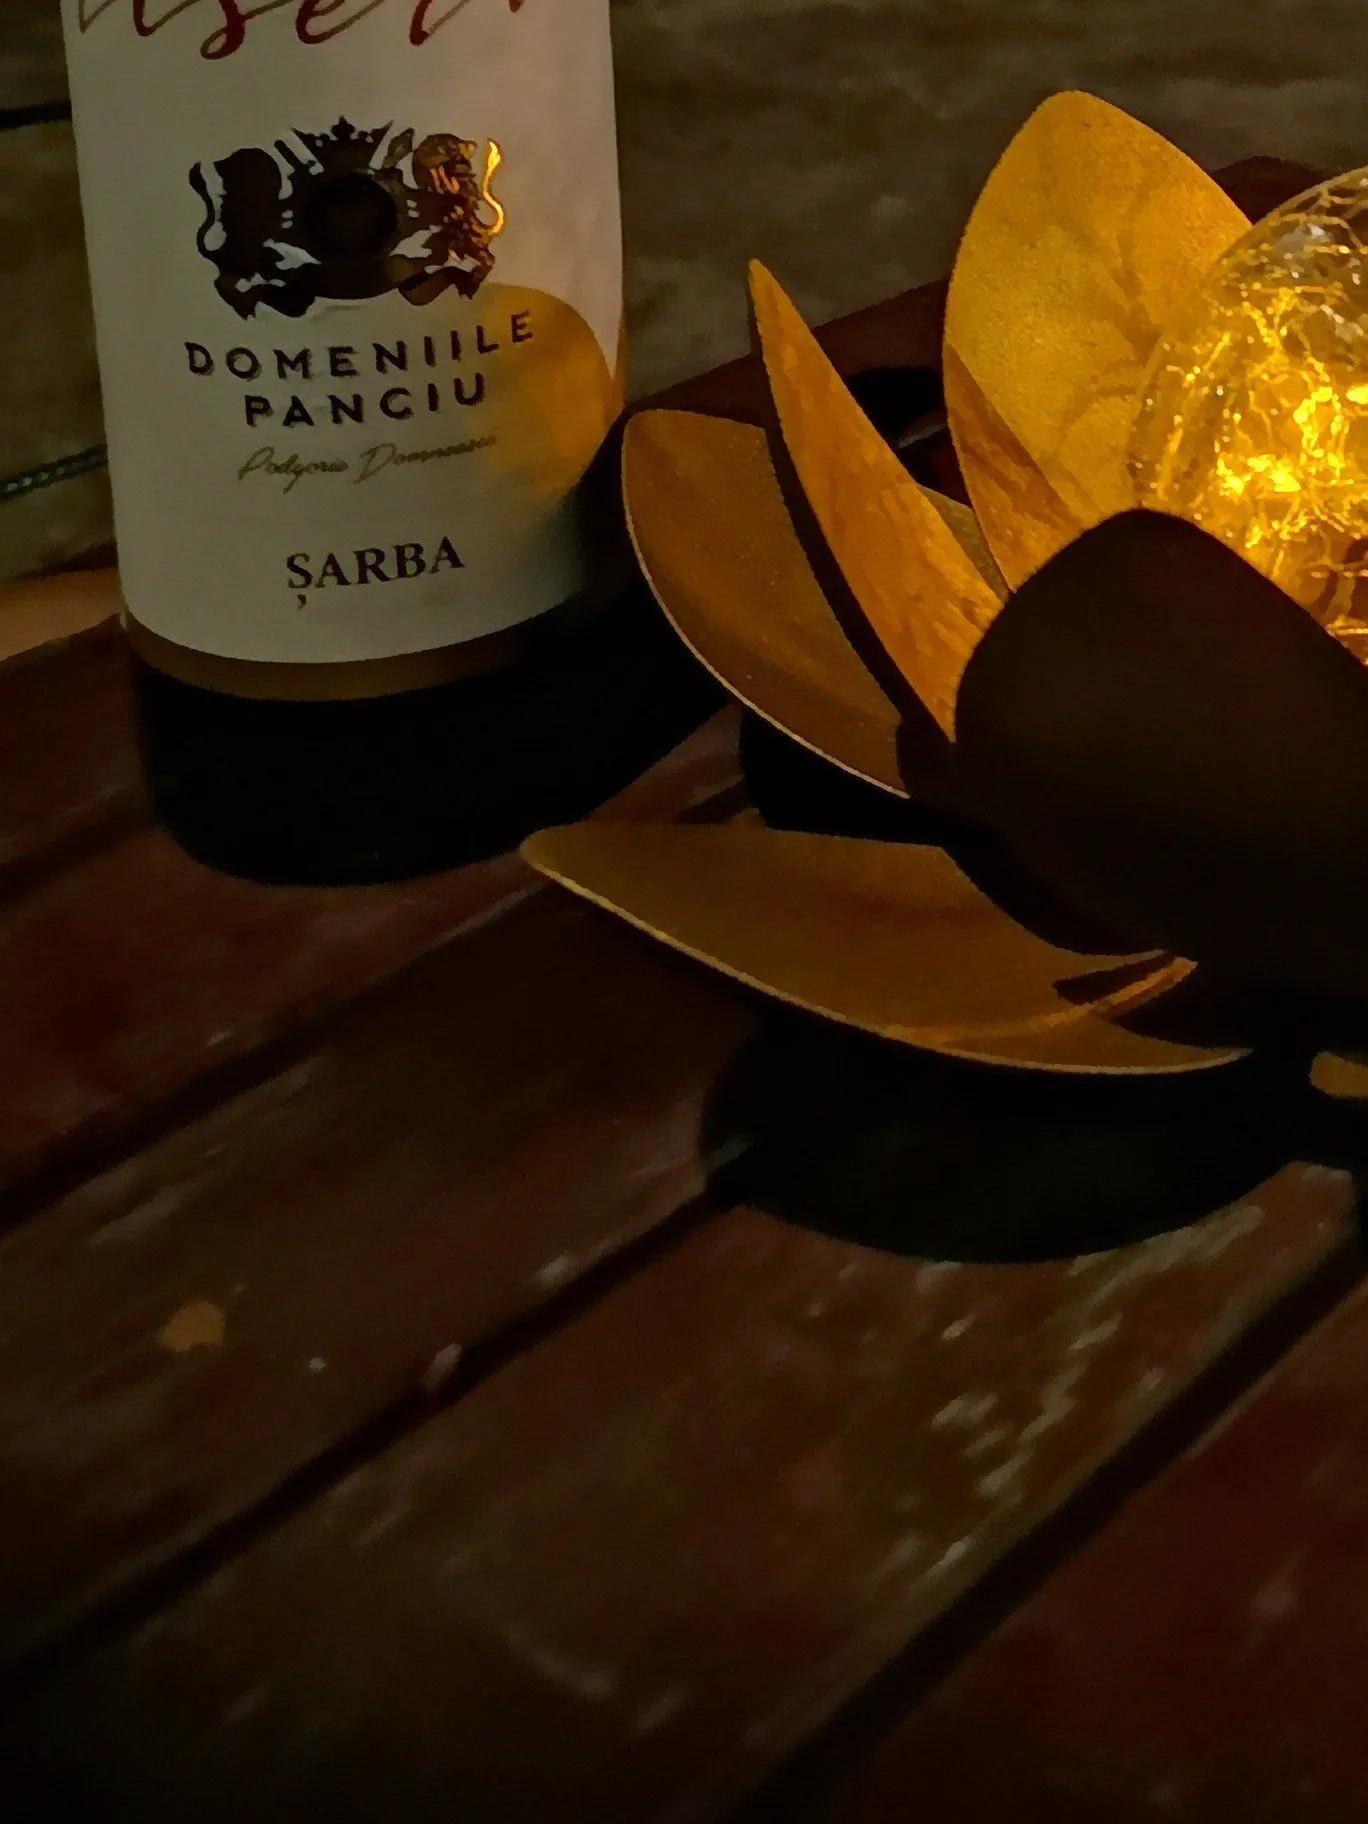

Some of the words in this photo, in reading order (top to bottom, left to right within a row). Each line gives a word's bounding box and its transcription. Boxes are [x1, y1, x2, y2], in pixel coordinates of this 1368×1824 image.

[185, 310, 534, 380] DOMENIILE
[244, 373, 485, 427] PANCIU
[286, 536, 466, 609] ȘARBA
